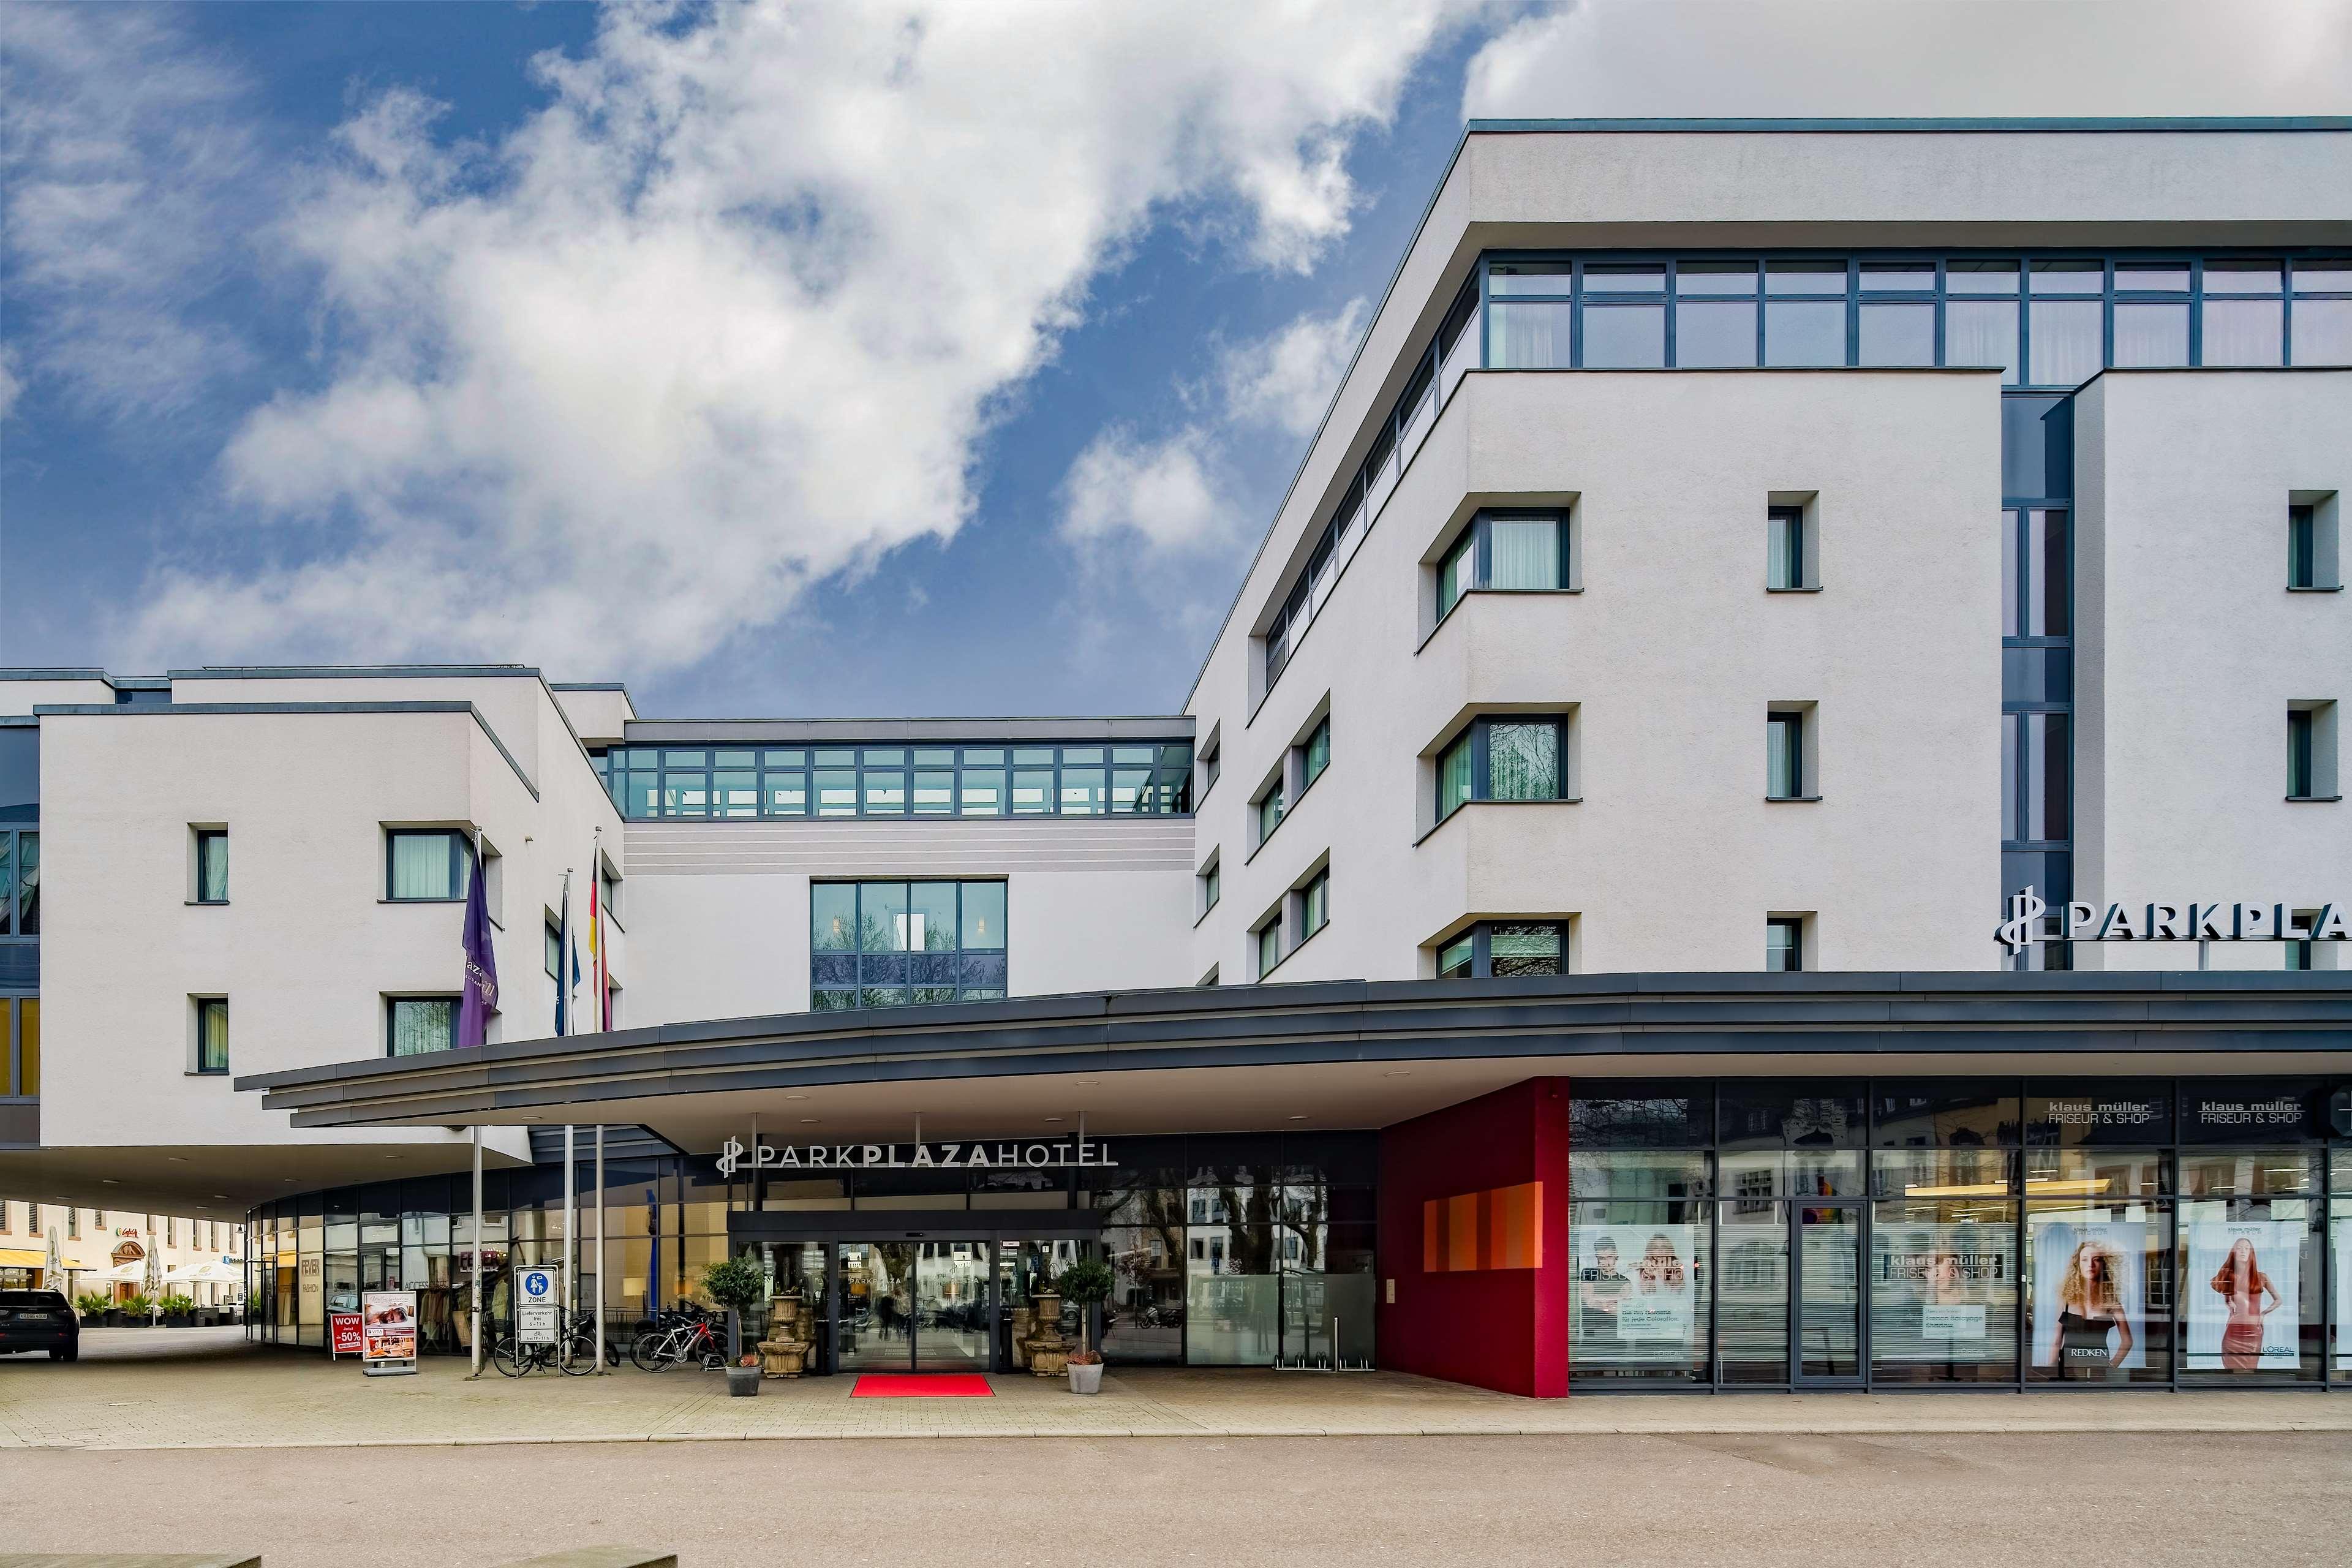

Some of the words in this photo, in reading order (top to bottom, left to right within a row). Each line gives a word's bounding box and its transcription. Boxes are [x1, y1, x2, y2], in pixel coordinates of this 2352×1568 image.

[2049, 1102, 2092, 1111] klaus
[2098, 1102, 2149, 1111] müller
[2202, 1102, 2244, 1111] klaus
[2251, 1102, 2302, 1111] müller
[2049, 1113, 2098, 1124] FRISEUR
[2103, 1113, 2113, 1124] &
[2116, 1113, 2150, 1124] SHOP
[2201, 1113, 2251, 1123] FRISEUR
[2255, 1113, 2265, 1123] &
[2269, 1113, 2302, 1123] SHOP
[1891, 1256, 1936, 1266] klaus
[1943, 1255, 1998, 1266] müller
[1949, 1267, 1959, 1278] &
[1962, 1267, 1998, 1278] SHOP
[2071, 1348, 2107, 1357] REDKEN
